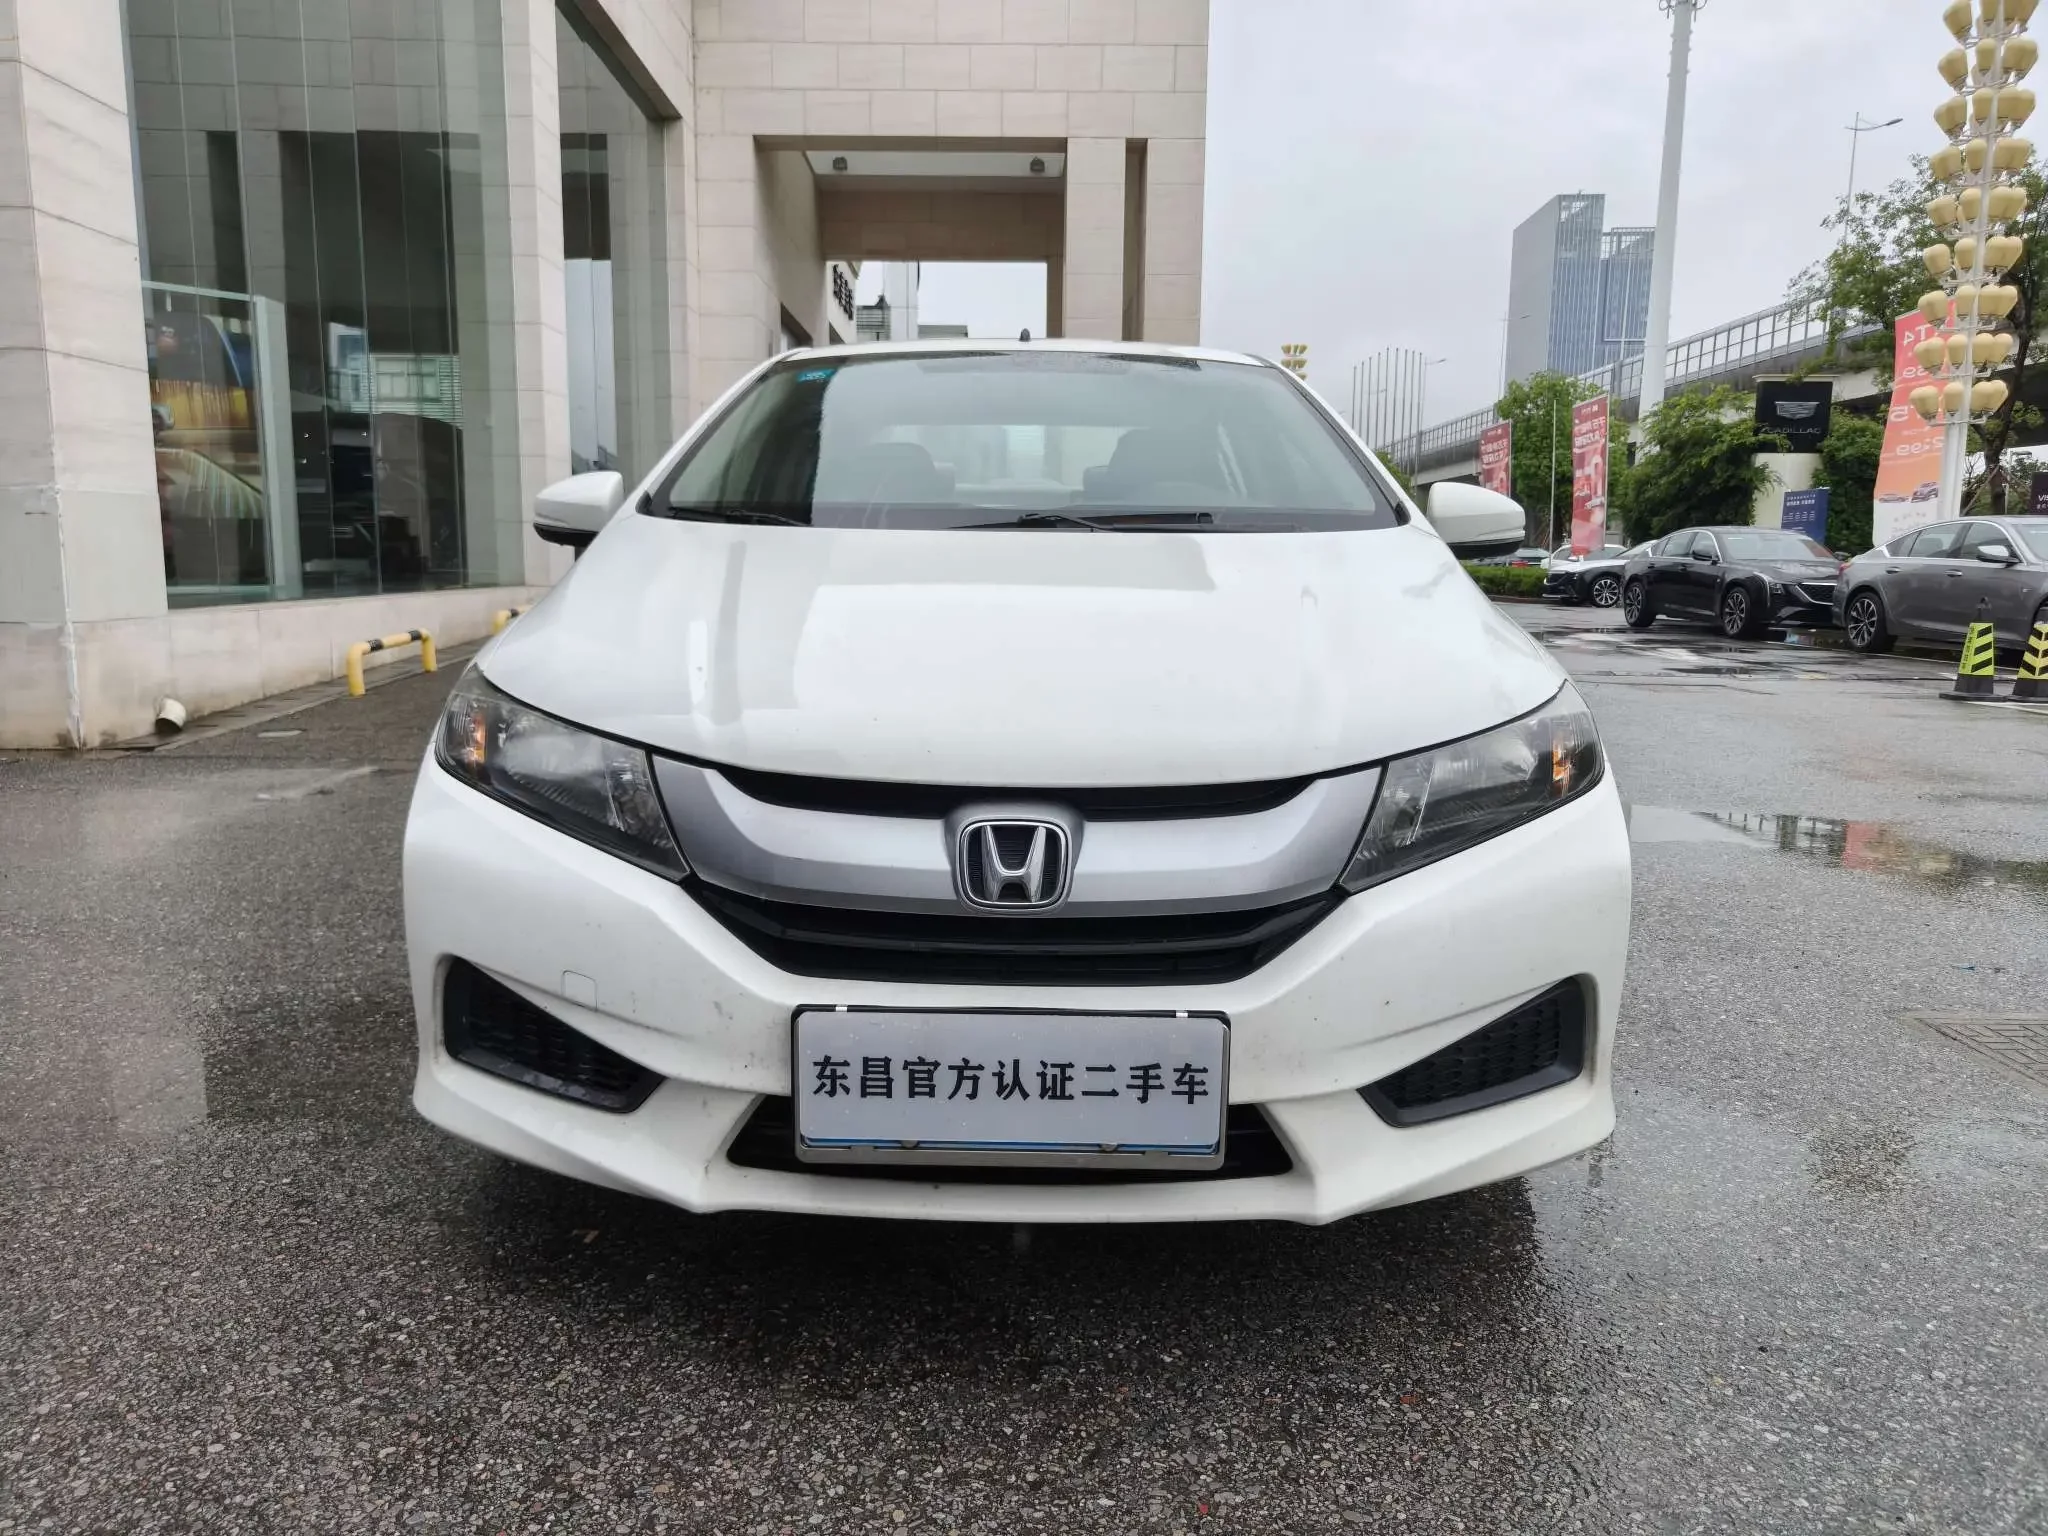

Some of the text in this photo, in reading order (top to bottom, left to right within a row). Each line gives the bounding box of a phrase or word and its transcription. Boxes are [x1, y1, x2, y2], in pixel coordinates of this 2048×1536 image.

[812, 1055, 1209, 1105] 东昌官方认证二手车
